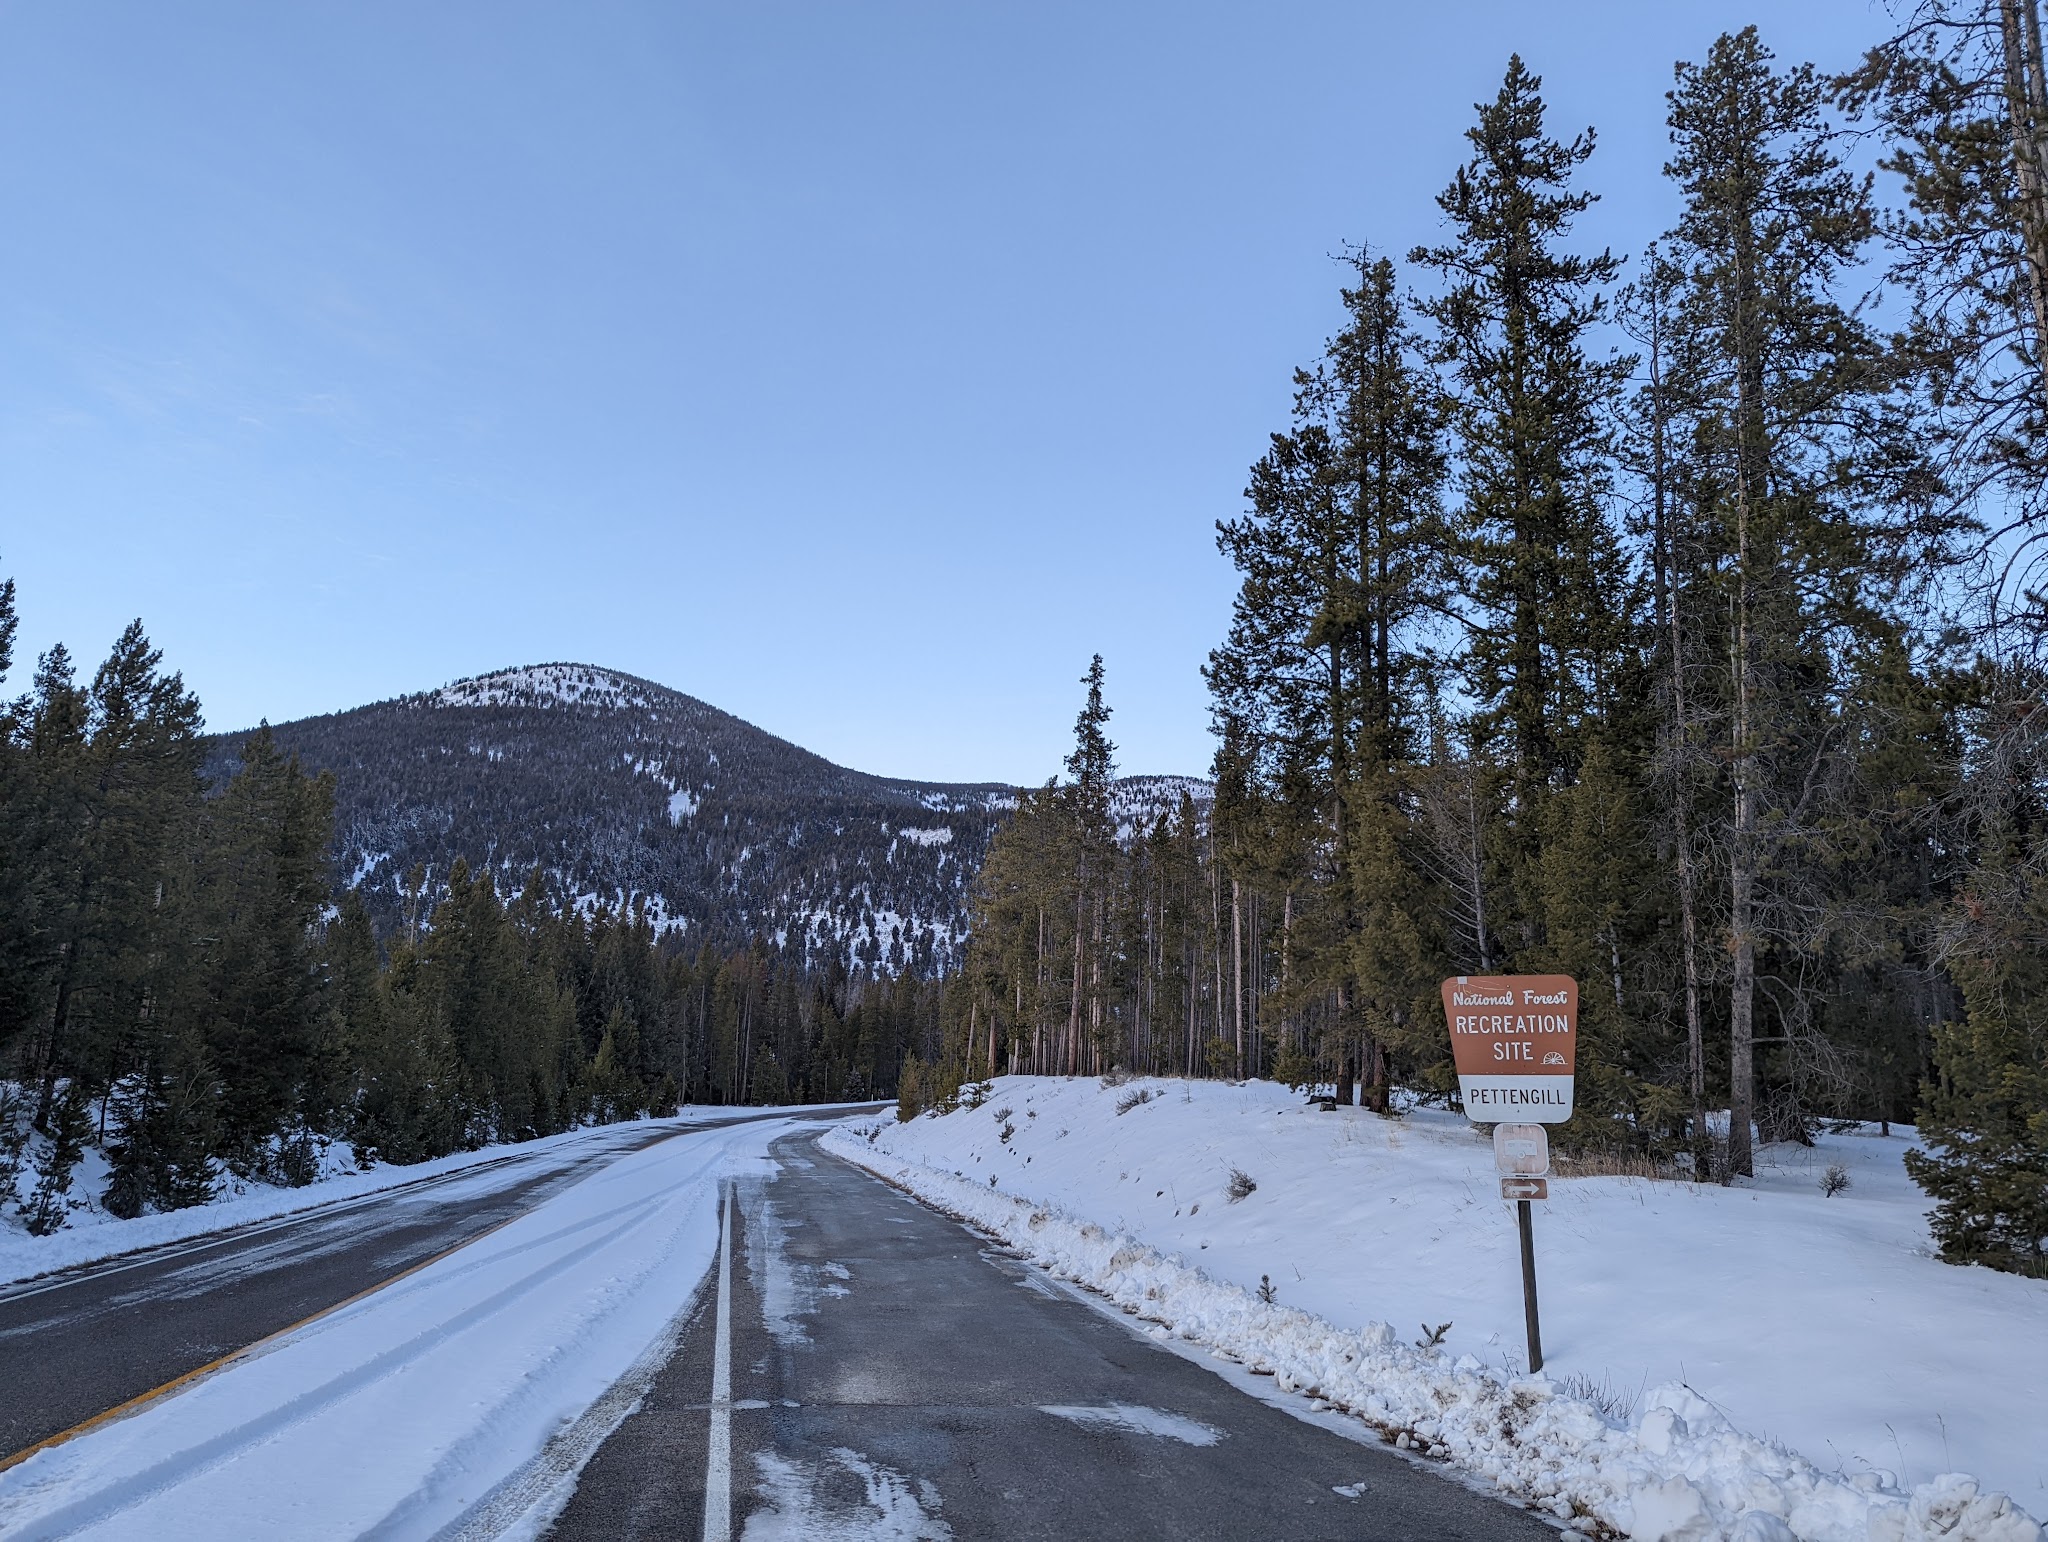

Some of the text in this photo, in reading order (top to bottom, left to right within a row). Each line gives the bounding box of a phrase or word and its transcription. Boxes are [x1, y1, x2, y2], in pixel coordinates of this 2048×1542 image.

[1453, 990, 1568, 1006] National Forest
[1456, 1015, 1569, 1034] RECREATION
[1493, 1042, 1534, 1060] SITE
[1470, 1089, 1566, 1105] PETTENGILL
